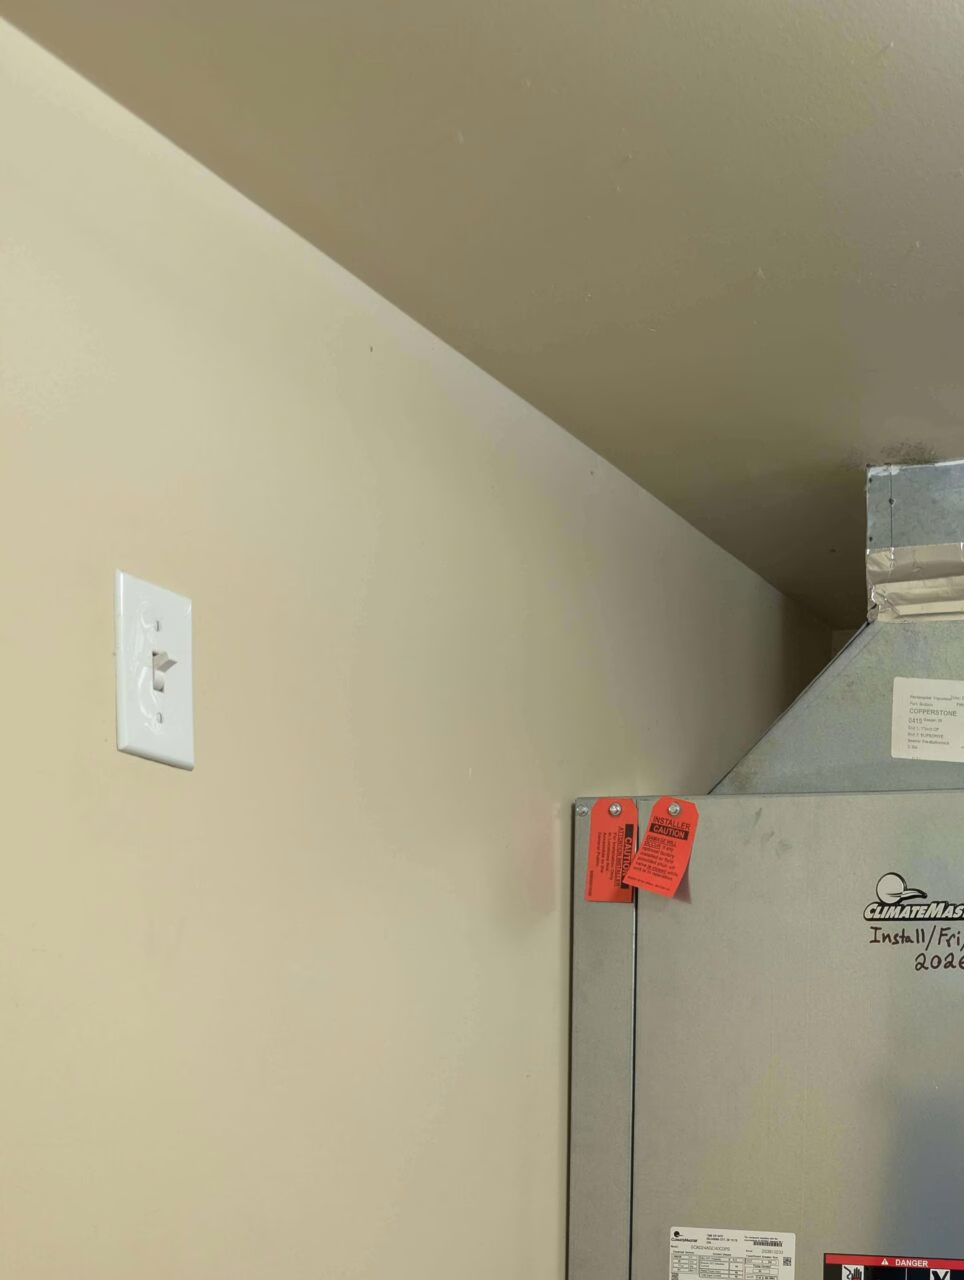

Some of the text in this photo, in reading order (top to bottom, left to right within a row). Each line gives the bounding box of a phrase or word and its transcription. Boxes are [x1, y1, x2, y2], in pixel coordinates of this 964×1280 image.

[909, 708, 958, 716] COPPERSTONE
[653, 815, 691, 830] INSTALLER
[654, 825, 685, 838] CAUTION
[895, 1256, 928, 1268] DANGER
